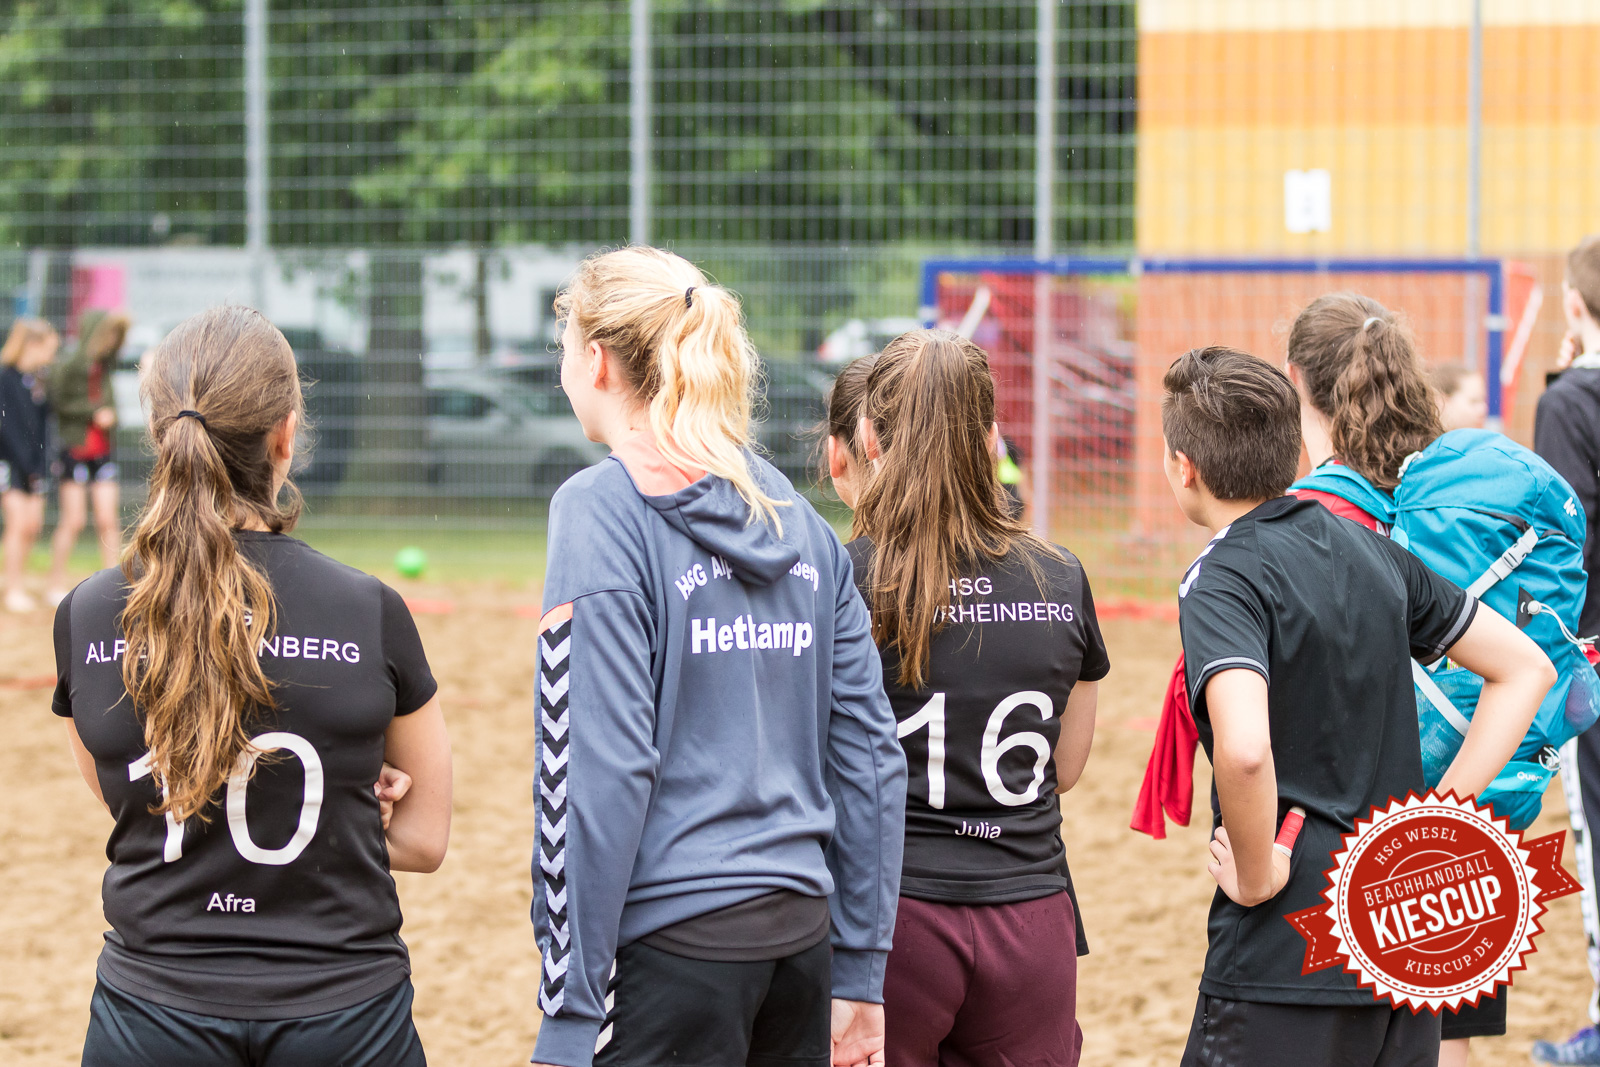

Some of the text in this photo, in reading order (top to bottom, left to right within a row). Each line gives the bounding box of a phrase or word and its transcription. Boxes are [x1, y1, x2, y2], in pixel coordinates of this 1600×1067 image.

[674, 563, 708, 601] HSG
[947, 577, 993, 596] HSG
[897, 690, 1054, 810] 16
[128, 731, 324, 866] 10
[954, 820, 1002, 840] Julia
[207, 892, 256, 913] Afra
